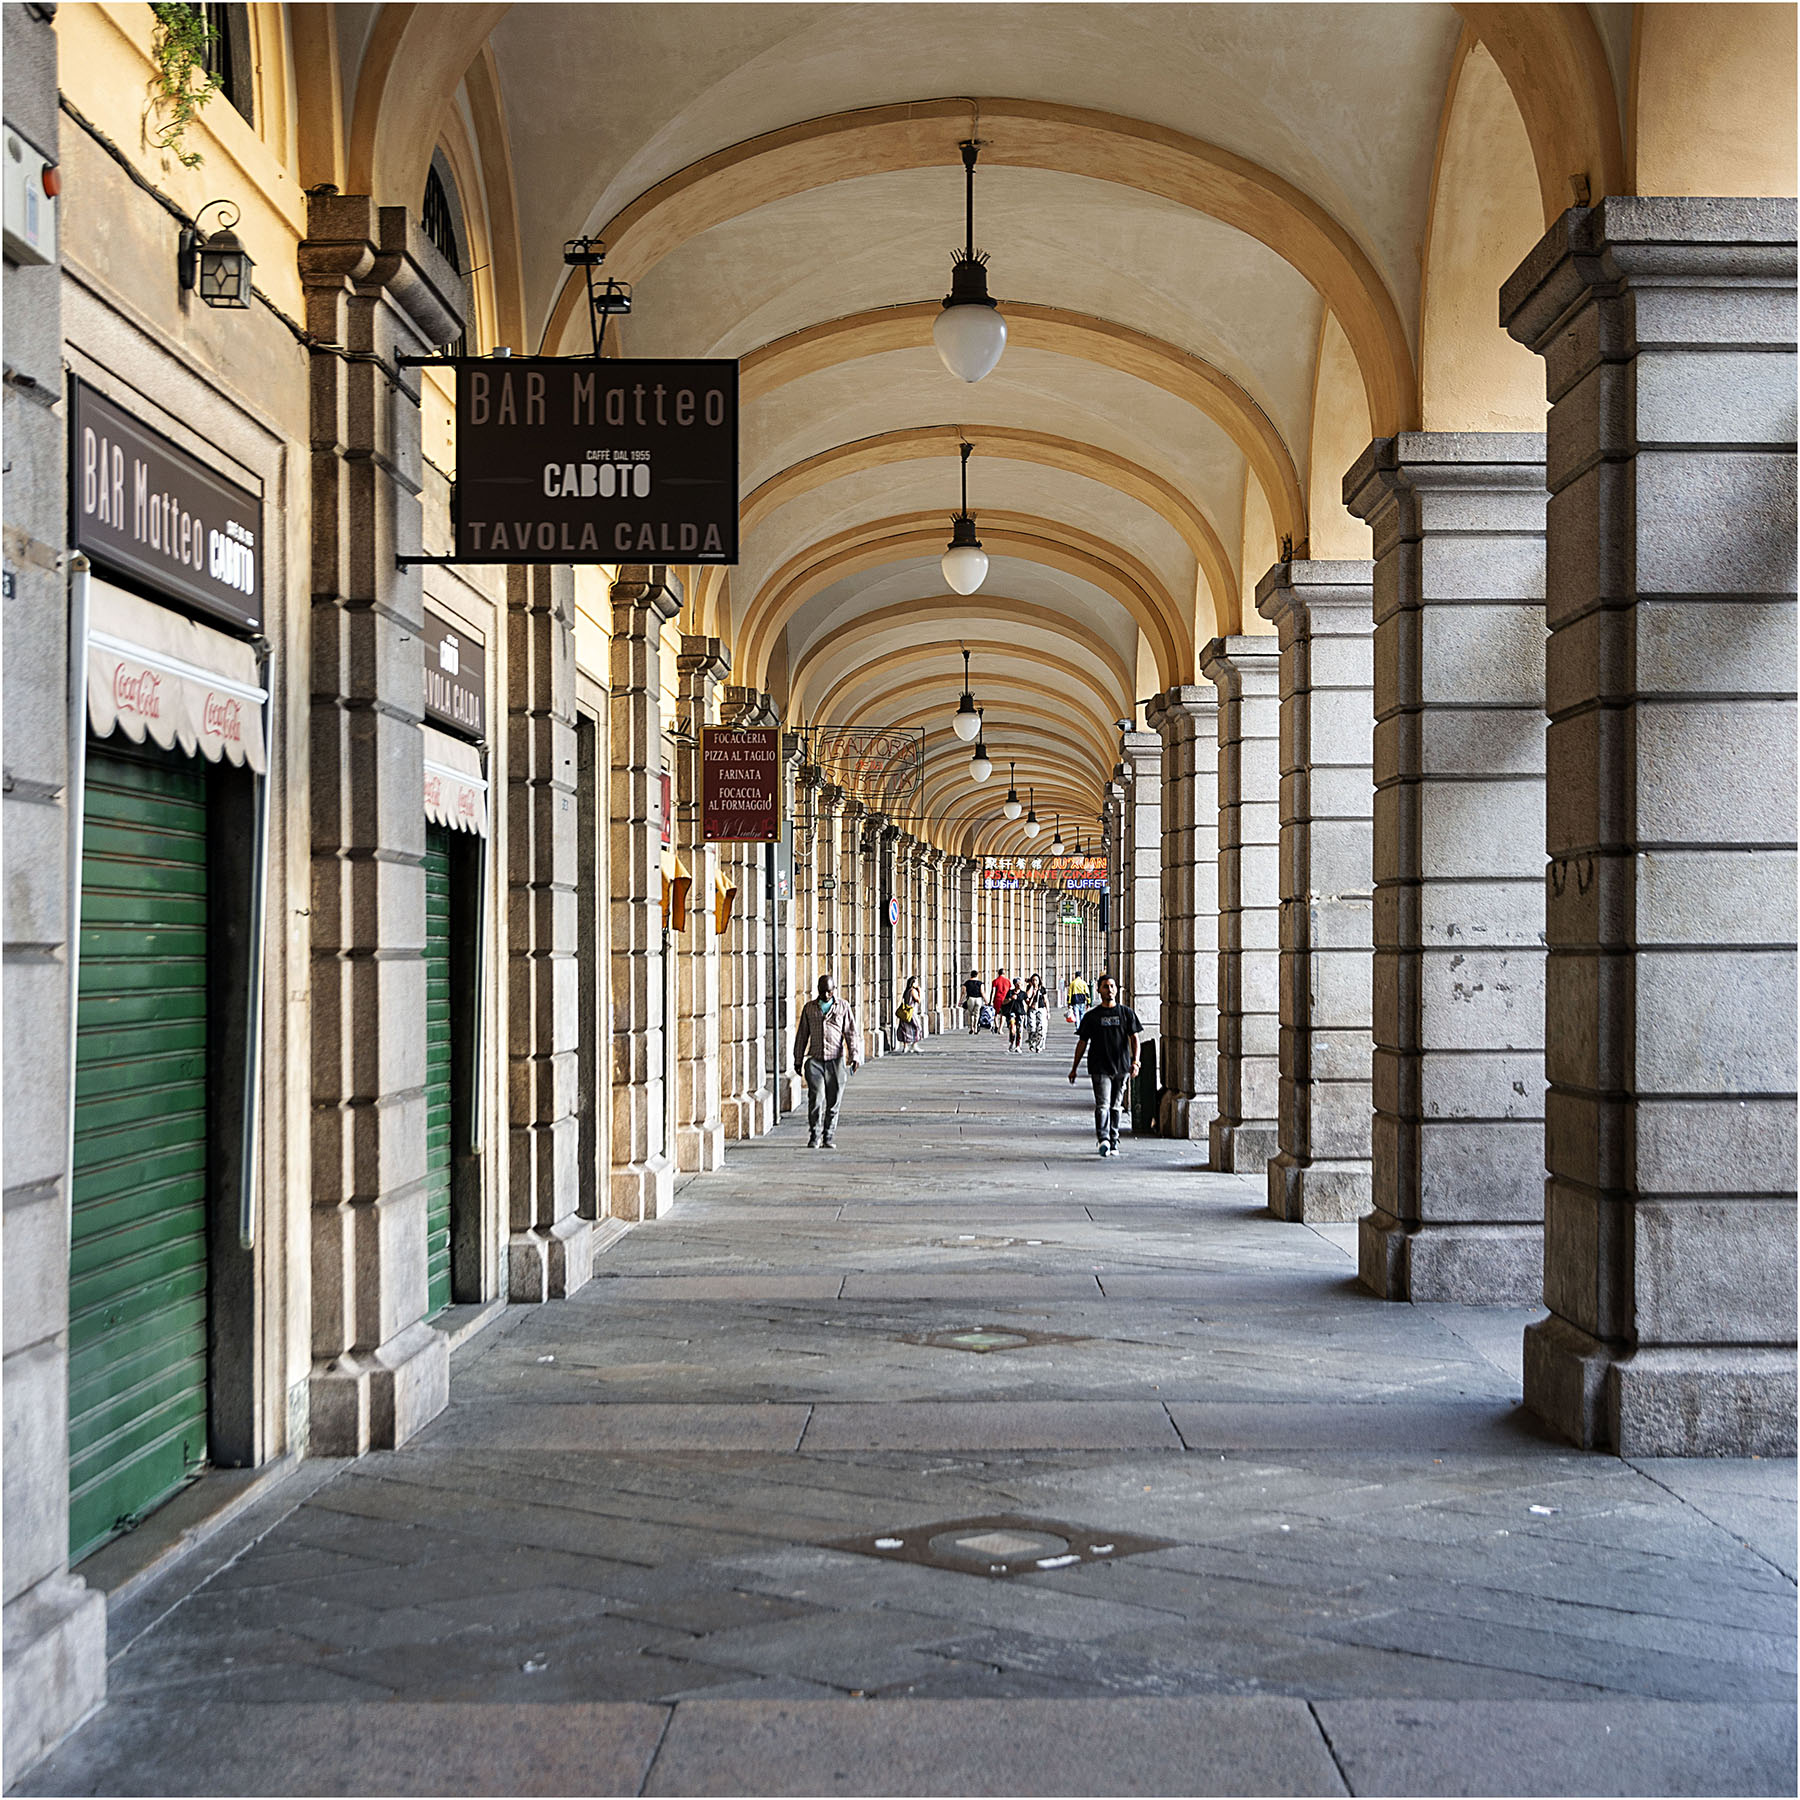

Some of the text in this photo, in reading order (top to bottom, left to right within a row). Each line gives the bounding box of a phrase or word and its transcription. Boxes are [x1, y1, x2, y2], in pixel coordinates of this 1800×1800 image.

[471, 372, 725, 426] BAR Matteo
[586, 449, 651, 461] CAFFÈ DAL 1955
[544, 463, 651, 497] CABOTO
[84, 426, 204, 571] BAR Matteo
[468, 522, 723, 551] TAVOLA CALDA
[713, 733, 768, 744] FOCACCERIA
[704, 750, 776, 761] PIZZA AL TAGLIO
[719, 769, 761, 780] FARINATA
[719, 787, 761, 799] FOCACCIA
[708, 799, 772, 811] AL FORMAGGIO
[1062, 869, 1108, 880] CINESE
[984, 879, 1108, 889] SUSHI BUFFET
